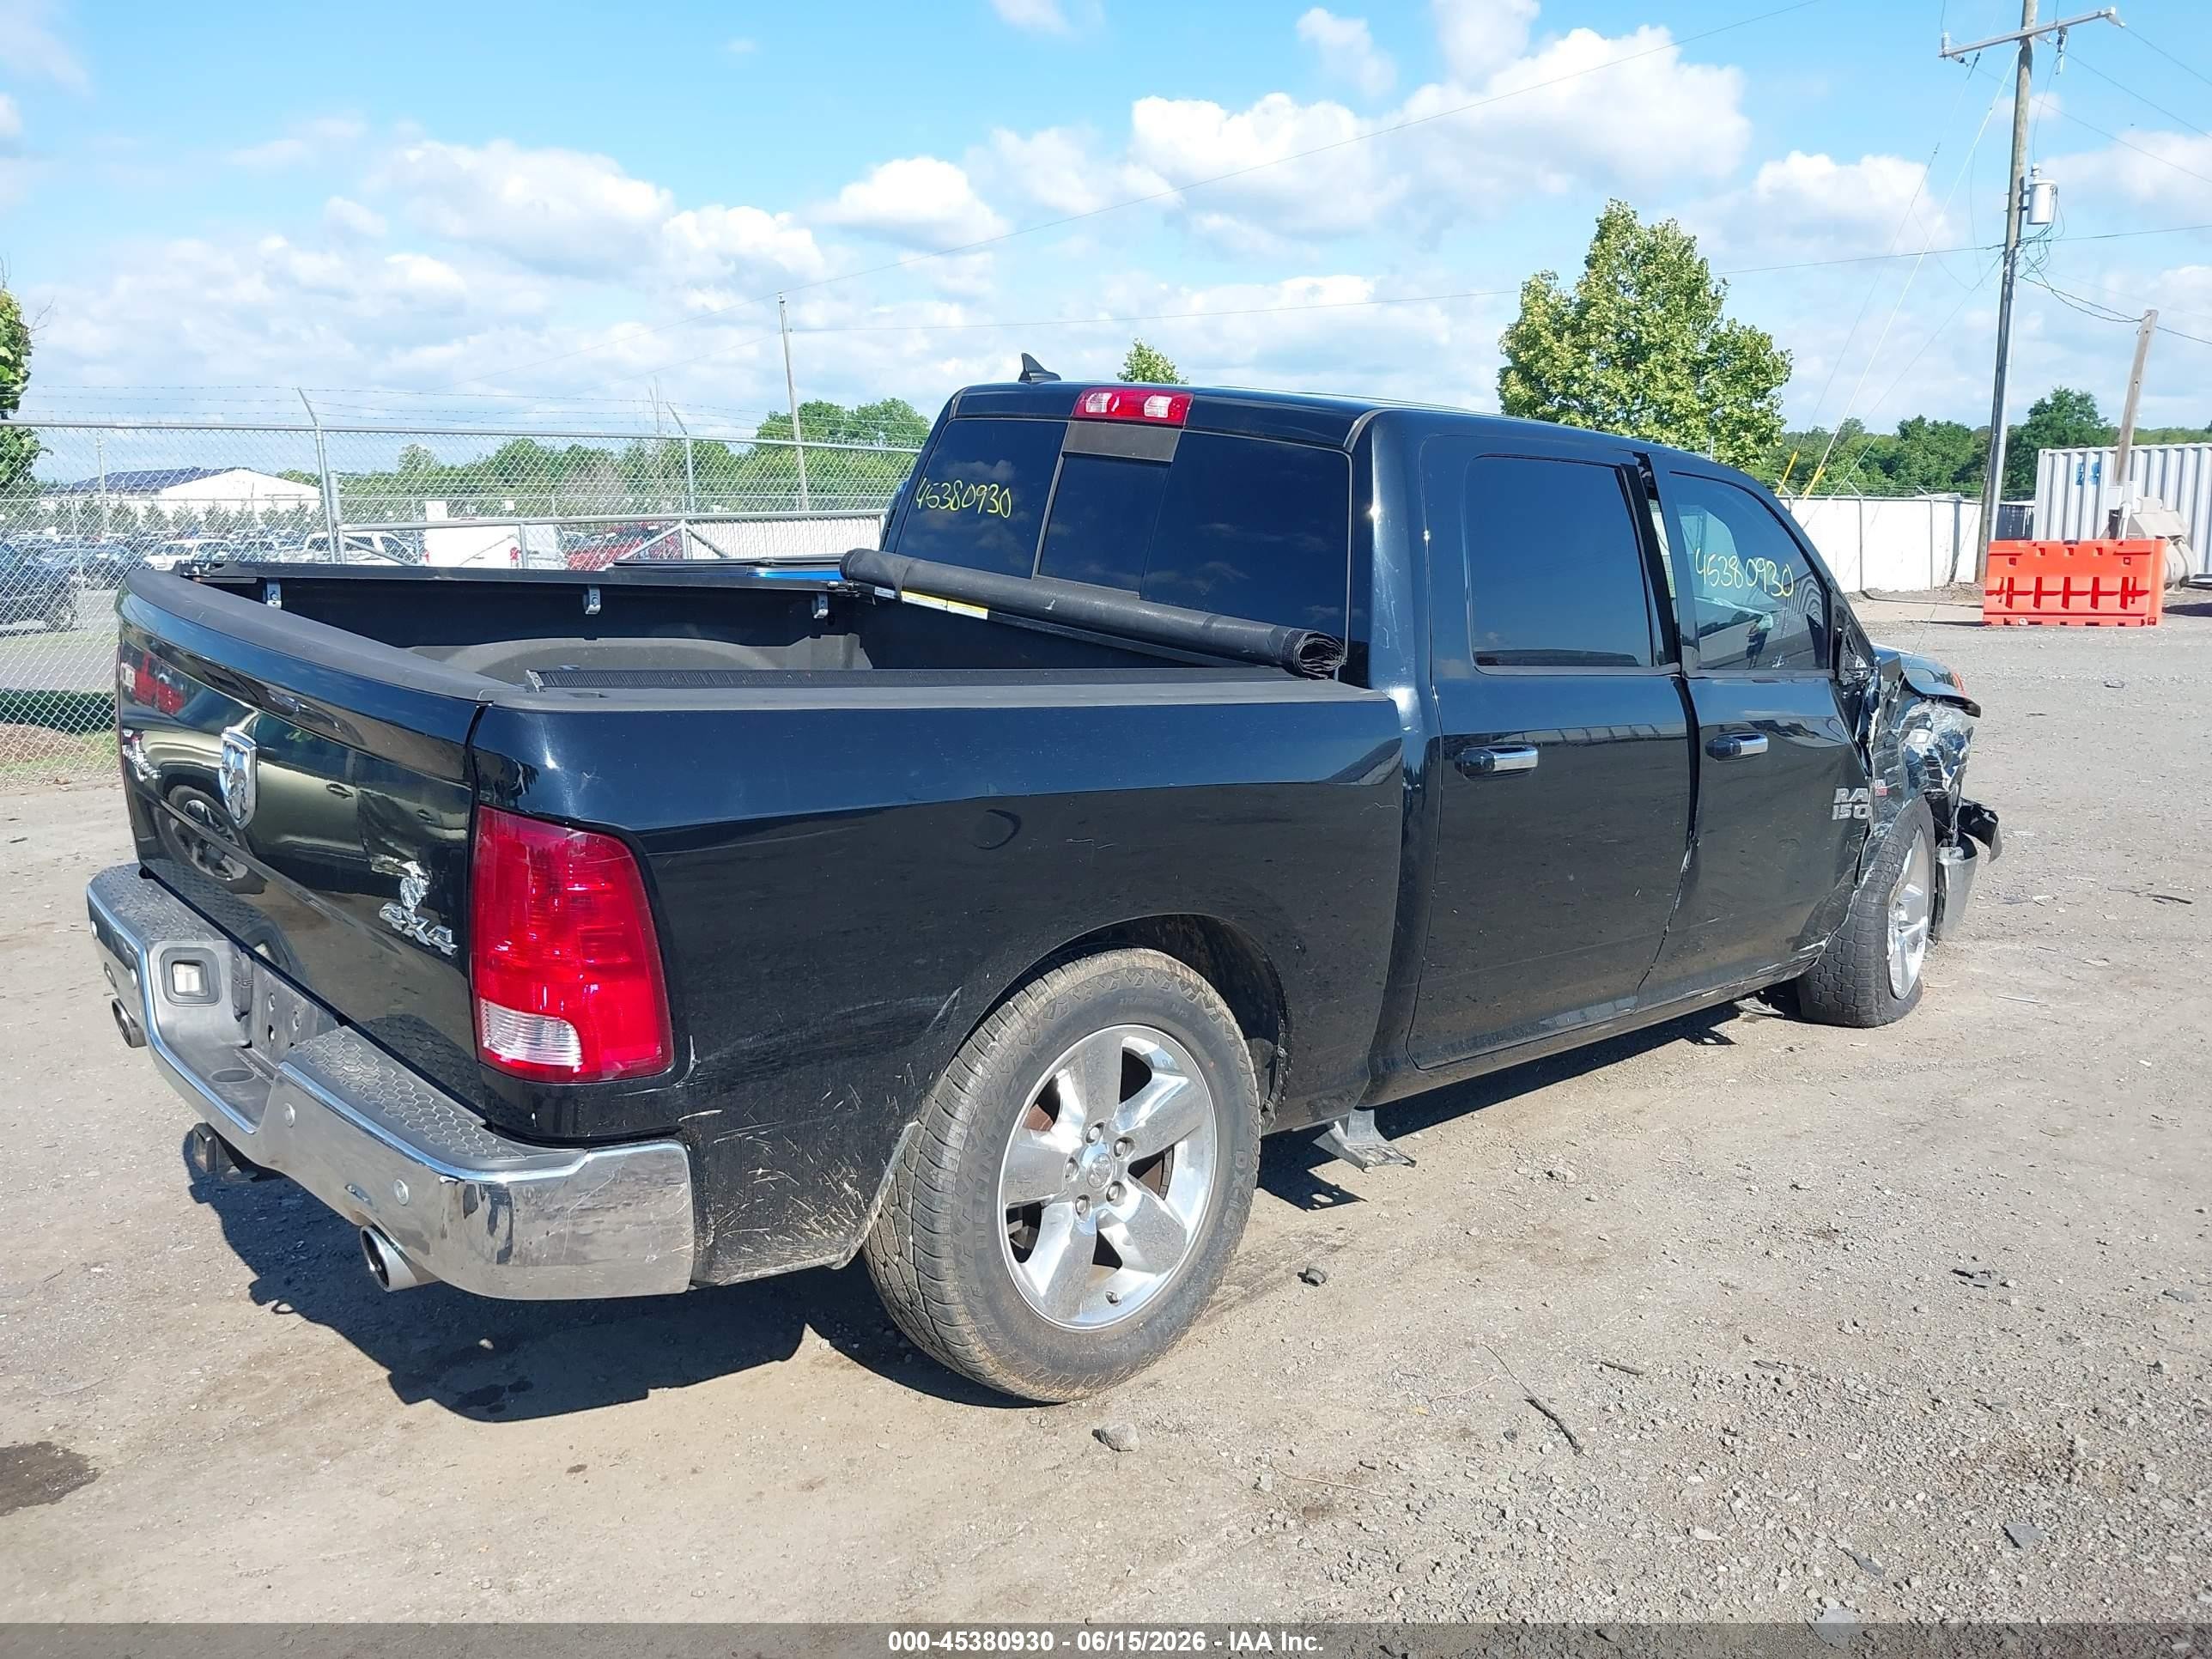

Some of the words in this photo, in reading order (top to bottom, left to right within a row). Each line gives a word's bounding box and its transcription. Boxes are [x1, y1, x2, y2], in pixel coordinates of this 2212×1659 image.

[916, 477, 1012, 518] 45380930
[1696, 548, 1794, 597] 45380930
[1833, 787, 1869, 803] RA
[1832, 804, 1873, 820] 150
